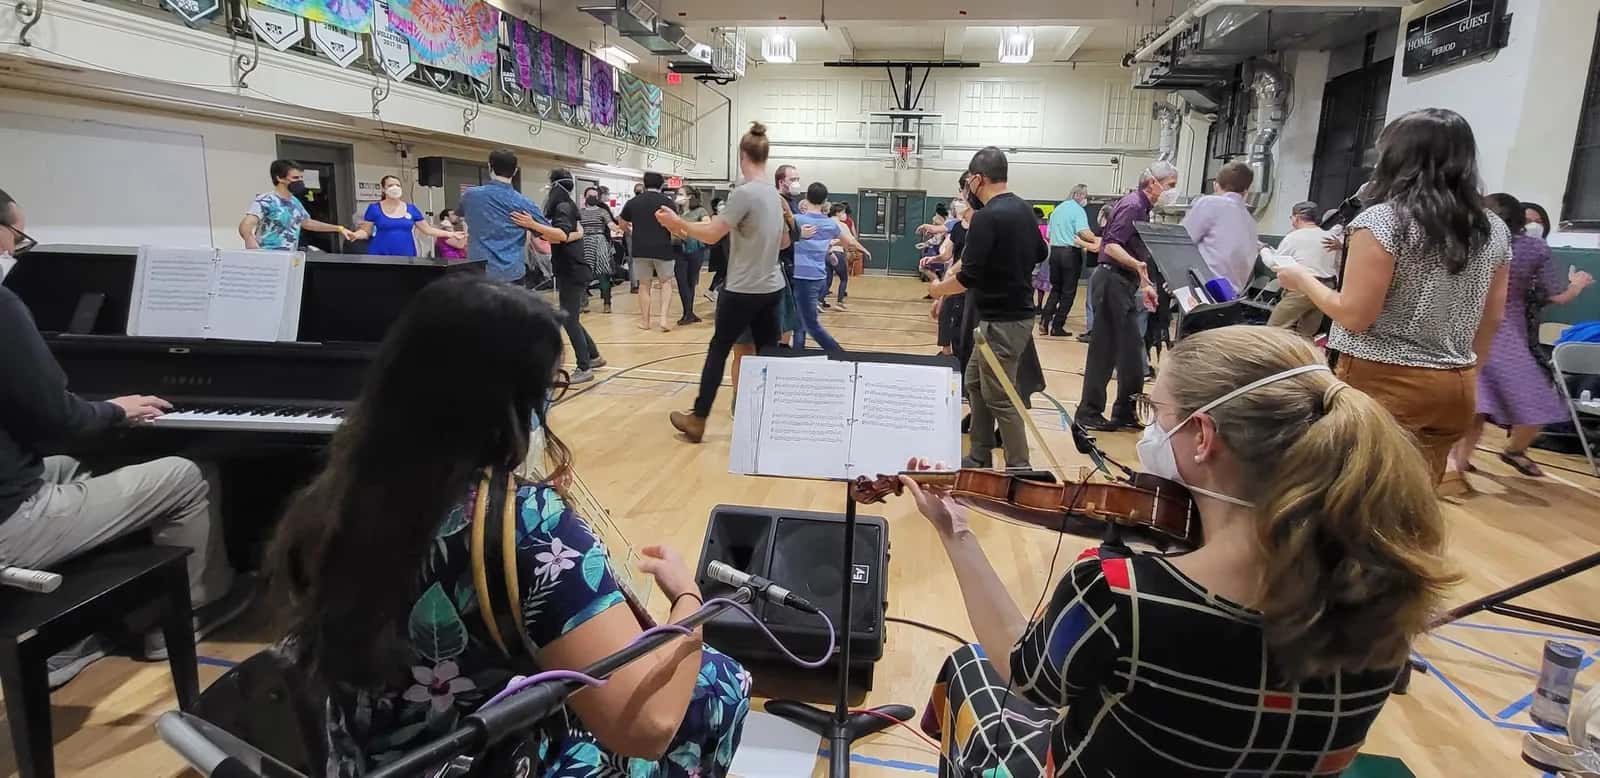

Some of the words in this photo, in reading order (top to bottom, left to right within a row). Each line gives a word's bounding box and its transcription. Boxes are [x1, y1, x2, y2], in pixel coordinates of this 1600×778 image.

[1459, 12, 1490, 32] GUEST
[1407, 34, 1432, 51] HOME
[1431, 42, 1456, 57] PERIOD
